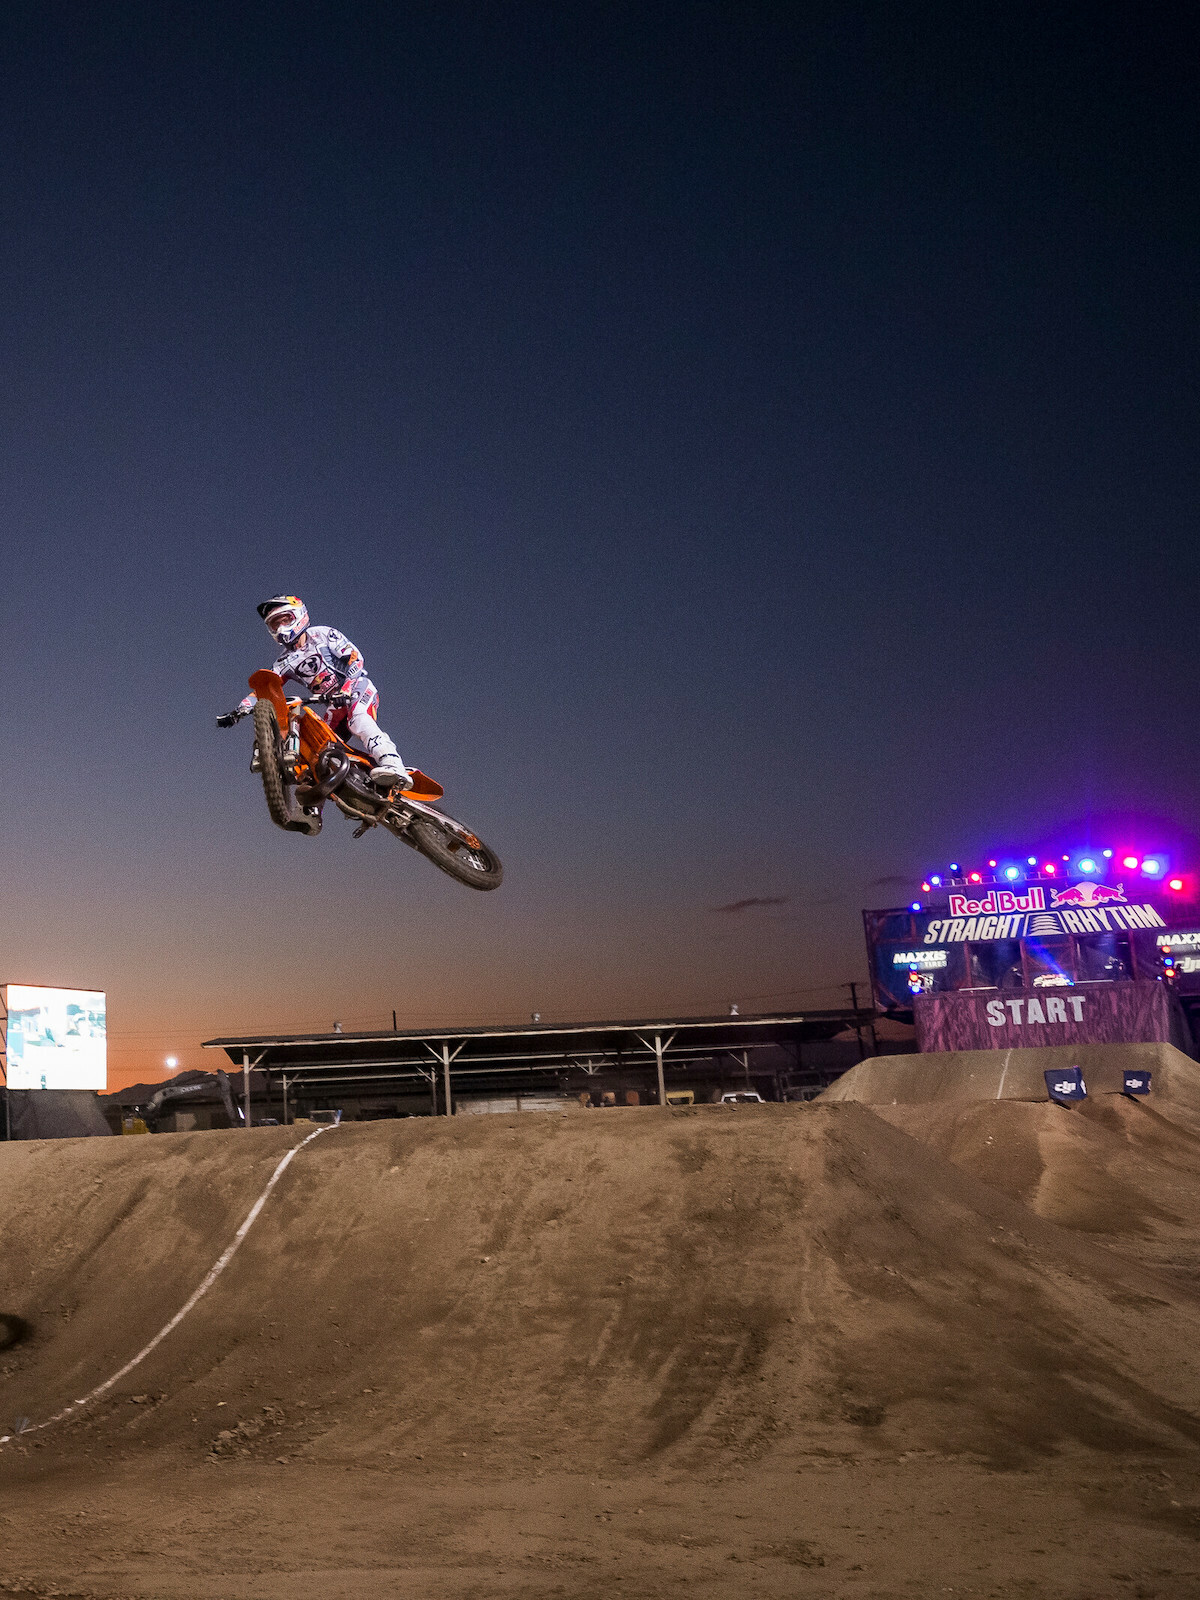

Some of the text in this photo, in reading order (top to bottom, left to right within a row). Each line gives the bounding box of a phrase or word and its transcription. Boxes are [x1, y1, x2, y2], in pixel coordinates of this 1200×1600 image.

[949, 886, 1045, 917] Red Bull
[924, 903, 1167, 944] STRAIGHT RHYTHM
[893, 950, 947, 963] MAXXIS
[986, 996, 1086, 1027] START
